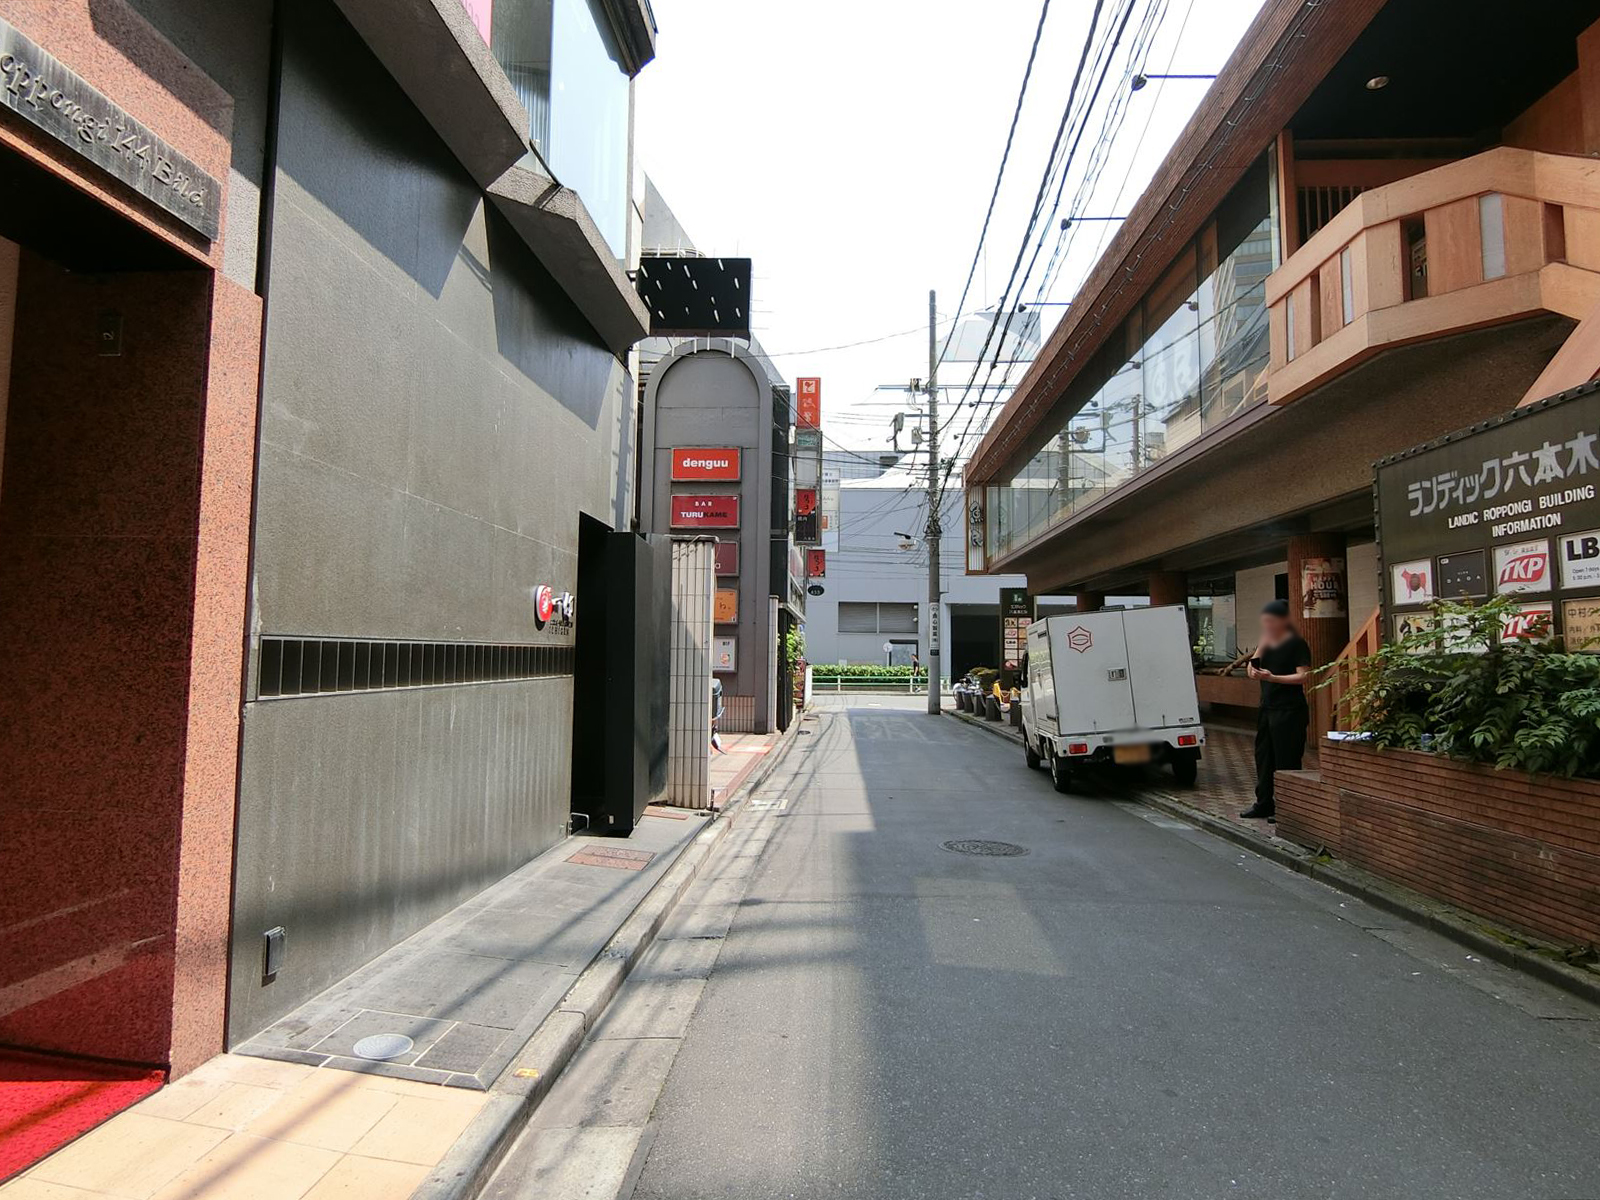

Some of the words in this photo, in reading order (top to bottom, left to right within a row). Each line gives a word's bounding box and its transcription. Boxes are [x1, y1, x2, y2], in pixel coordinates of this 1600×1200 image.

[110, 126, 152, 172] 144
[682, 457, 729, 470] denguu
[1407, 430, 1600, 517] ランディック六本木
[1447, 511, 1479, 529] LANDIC
[1483, 499, 1533, 522] ROPPONGI
[1538, 484, 1595, 509] BUILDING
[1491, 512, 1562, 538] INFORMATION
[1503, 556, 1544, 582] TKP
